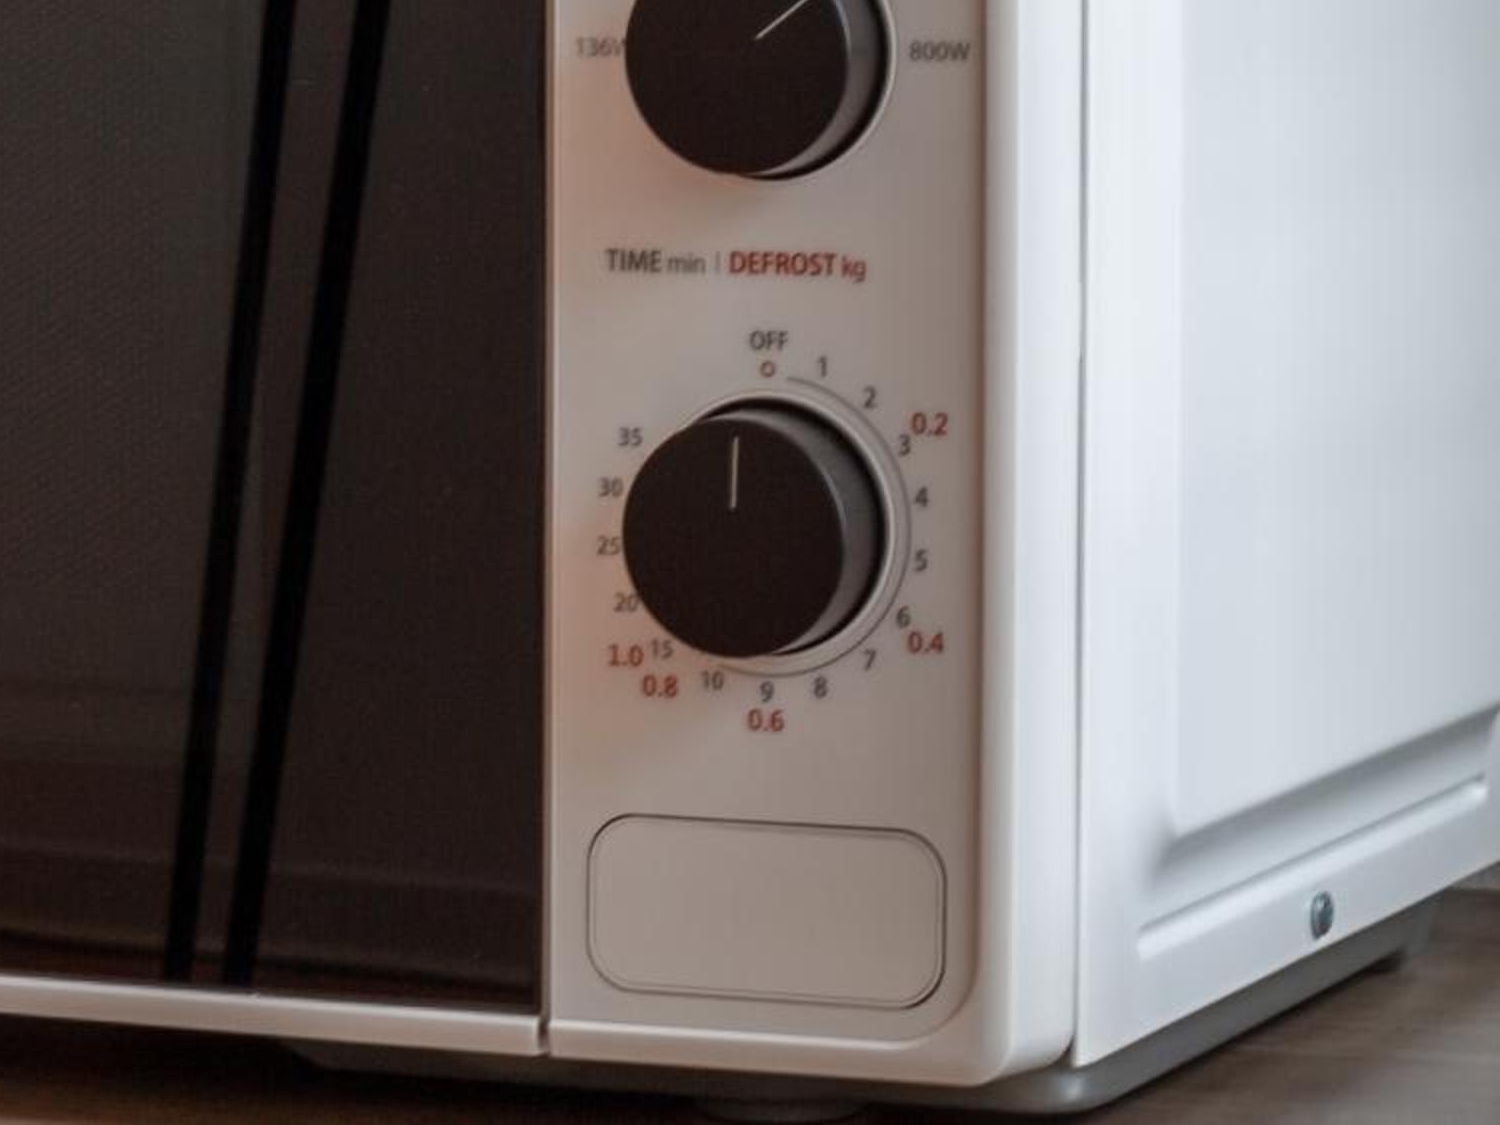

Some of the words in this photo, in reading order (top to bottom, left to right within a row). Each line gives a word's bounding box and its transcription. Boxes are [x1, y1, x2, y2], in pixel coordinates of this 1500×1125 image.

[909, 41, 970, 62] 800W
[605, 249, 662, 273] TIME
[666, 253, 706, 273] min
[729, 251, 836, 275] DEFROST
[841, 255, 867, 281] kg
[749, 331, 789, 350] OFF
[817, 356, 828, 375] 1
[863, 388, 877, 408] 2
[911, 413, 948, 436] 0.2
[617, 428, 642, 447] 35
[899, 435, 912, 456] 3
[599, 478, 624, 498] 30
[913, 487, 929, 507] 4
[597, 537, 621, 556] 25
[914, 552, 928, 572] 5
[614, 594, 639, 613] 20
[897, 606, 910, 628] 6
[650, 638, 673, 659] 15
[907, 631, 944, 654] 0.4
[608, 644, 644, 667] 1.0
[864, 650, 876, 671] 7
[642, 675, 678, 698] 0.8
[702, 670, 725, 690] 10
[813, 678, 828, 698] 8
[760, 681, 774, 703] 9
[748, 709, 784, 732] 0.6
